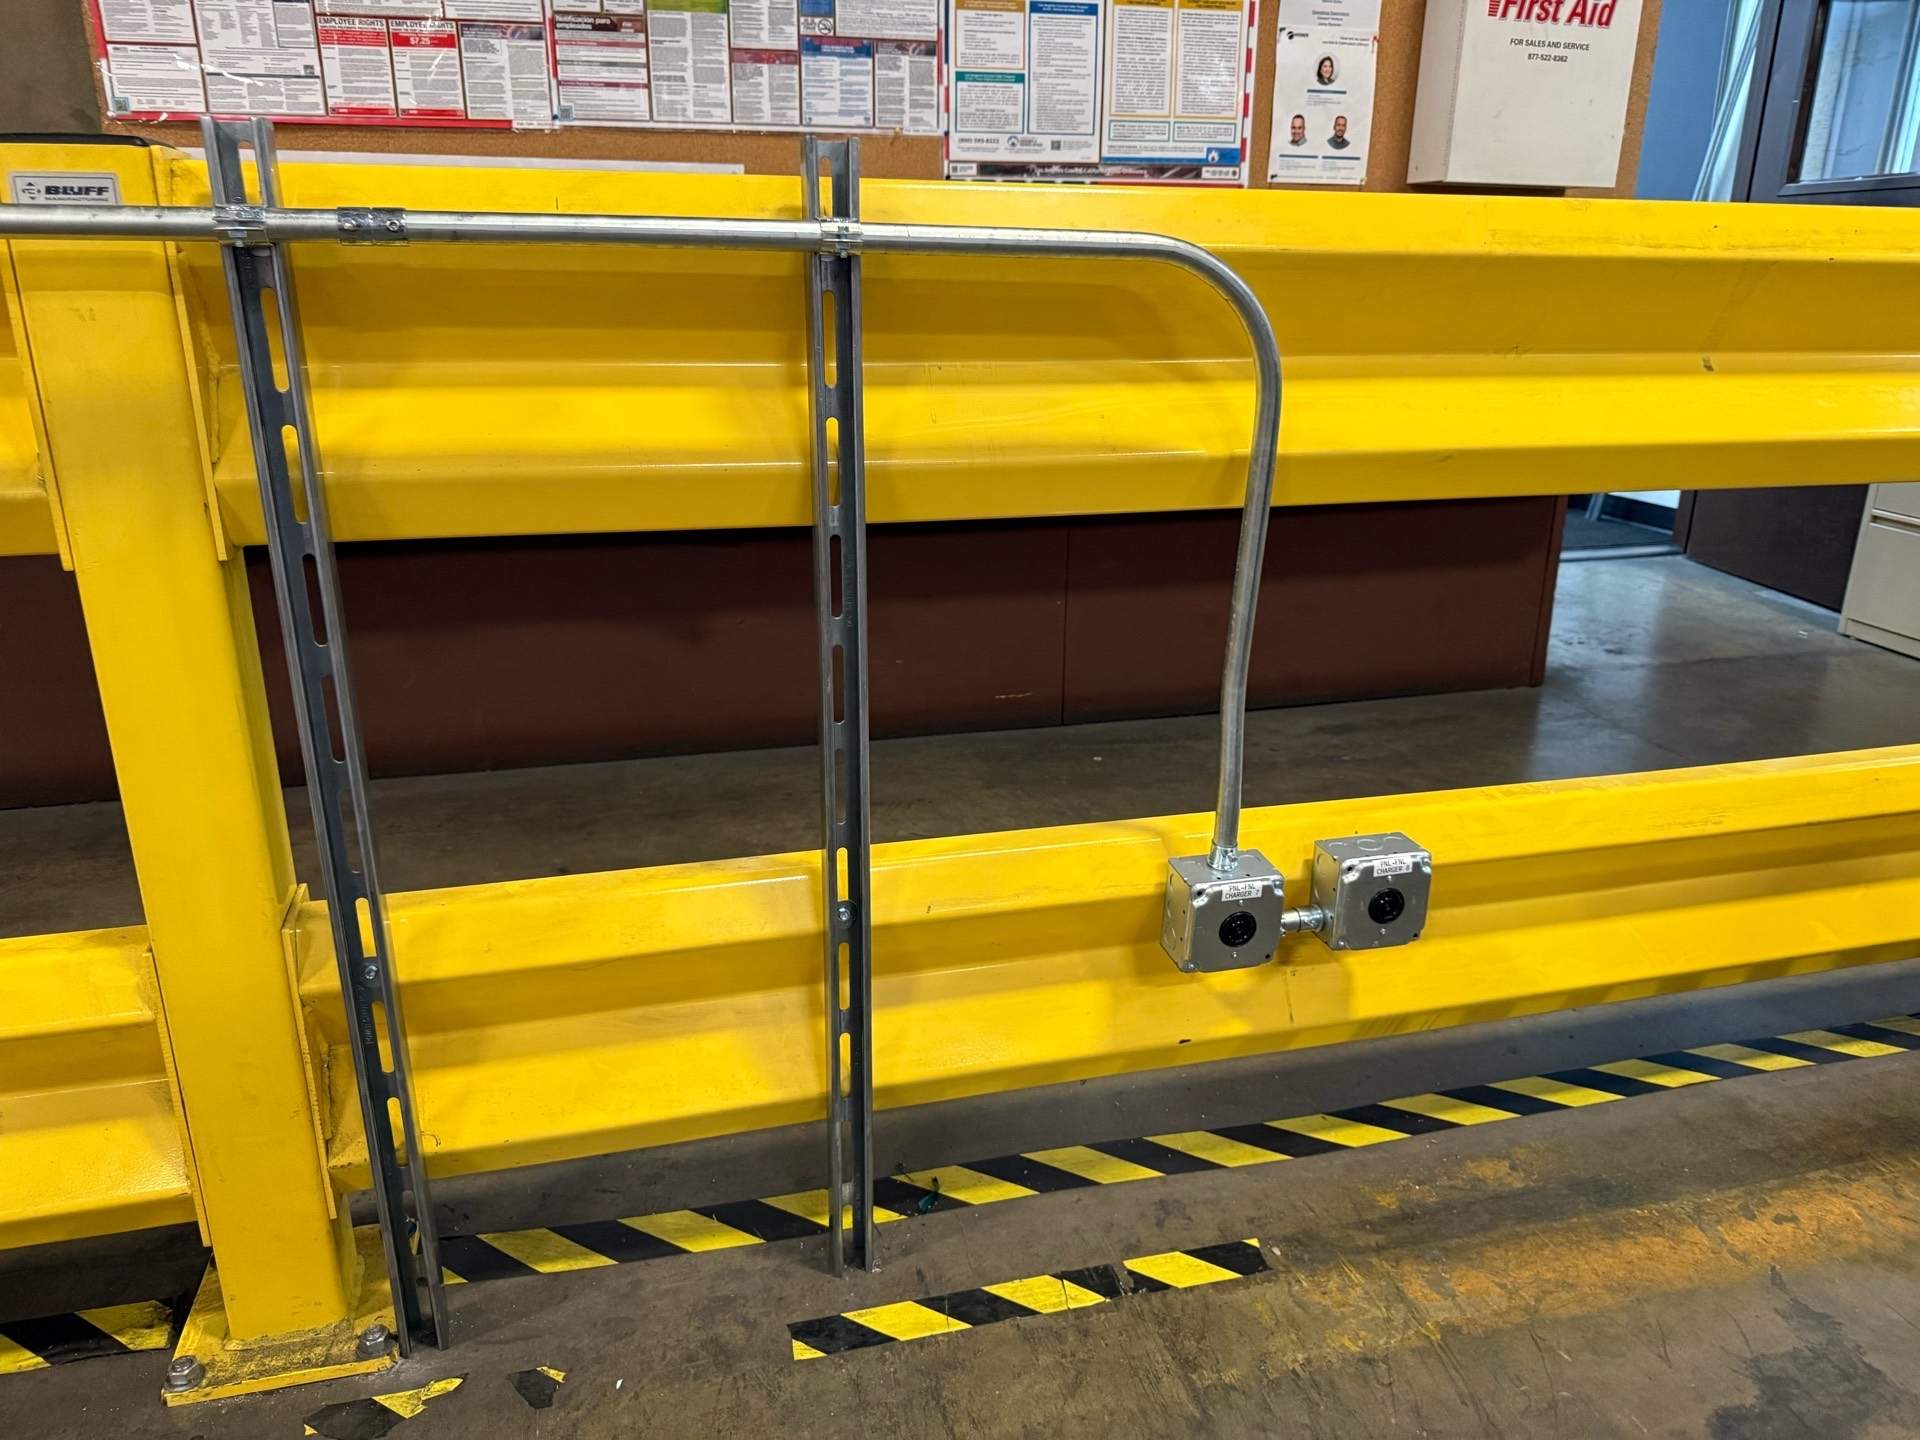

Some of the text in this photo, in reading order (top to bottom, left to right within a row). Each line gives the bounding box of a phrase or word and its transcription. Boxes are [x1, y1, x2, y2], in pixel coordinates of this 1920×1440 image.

[1500, 0, 1617, 27] First Aid
[319, 17, 357, 26] EMPLOYEE
[1510, 38, 1590, 51] FOR SALES AND SERVICE
[45, 185, 109, 196] BLUFF
[1376, 865, 1403, 874] CHARGER
[1225, 890, 1252, 899] CHARGER
